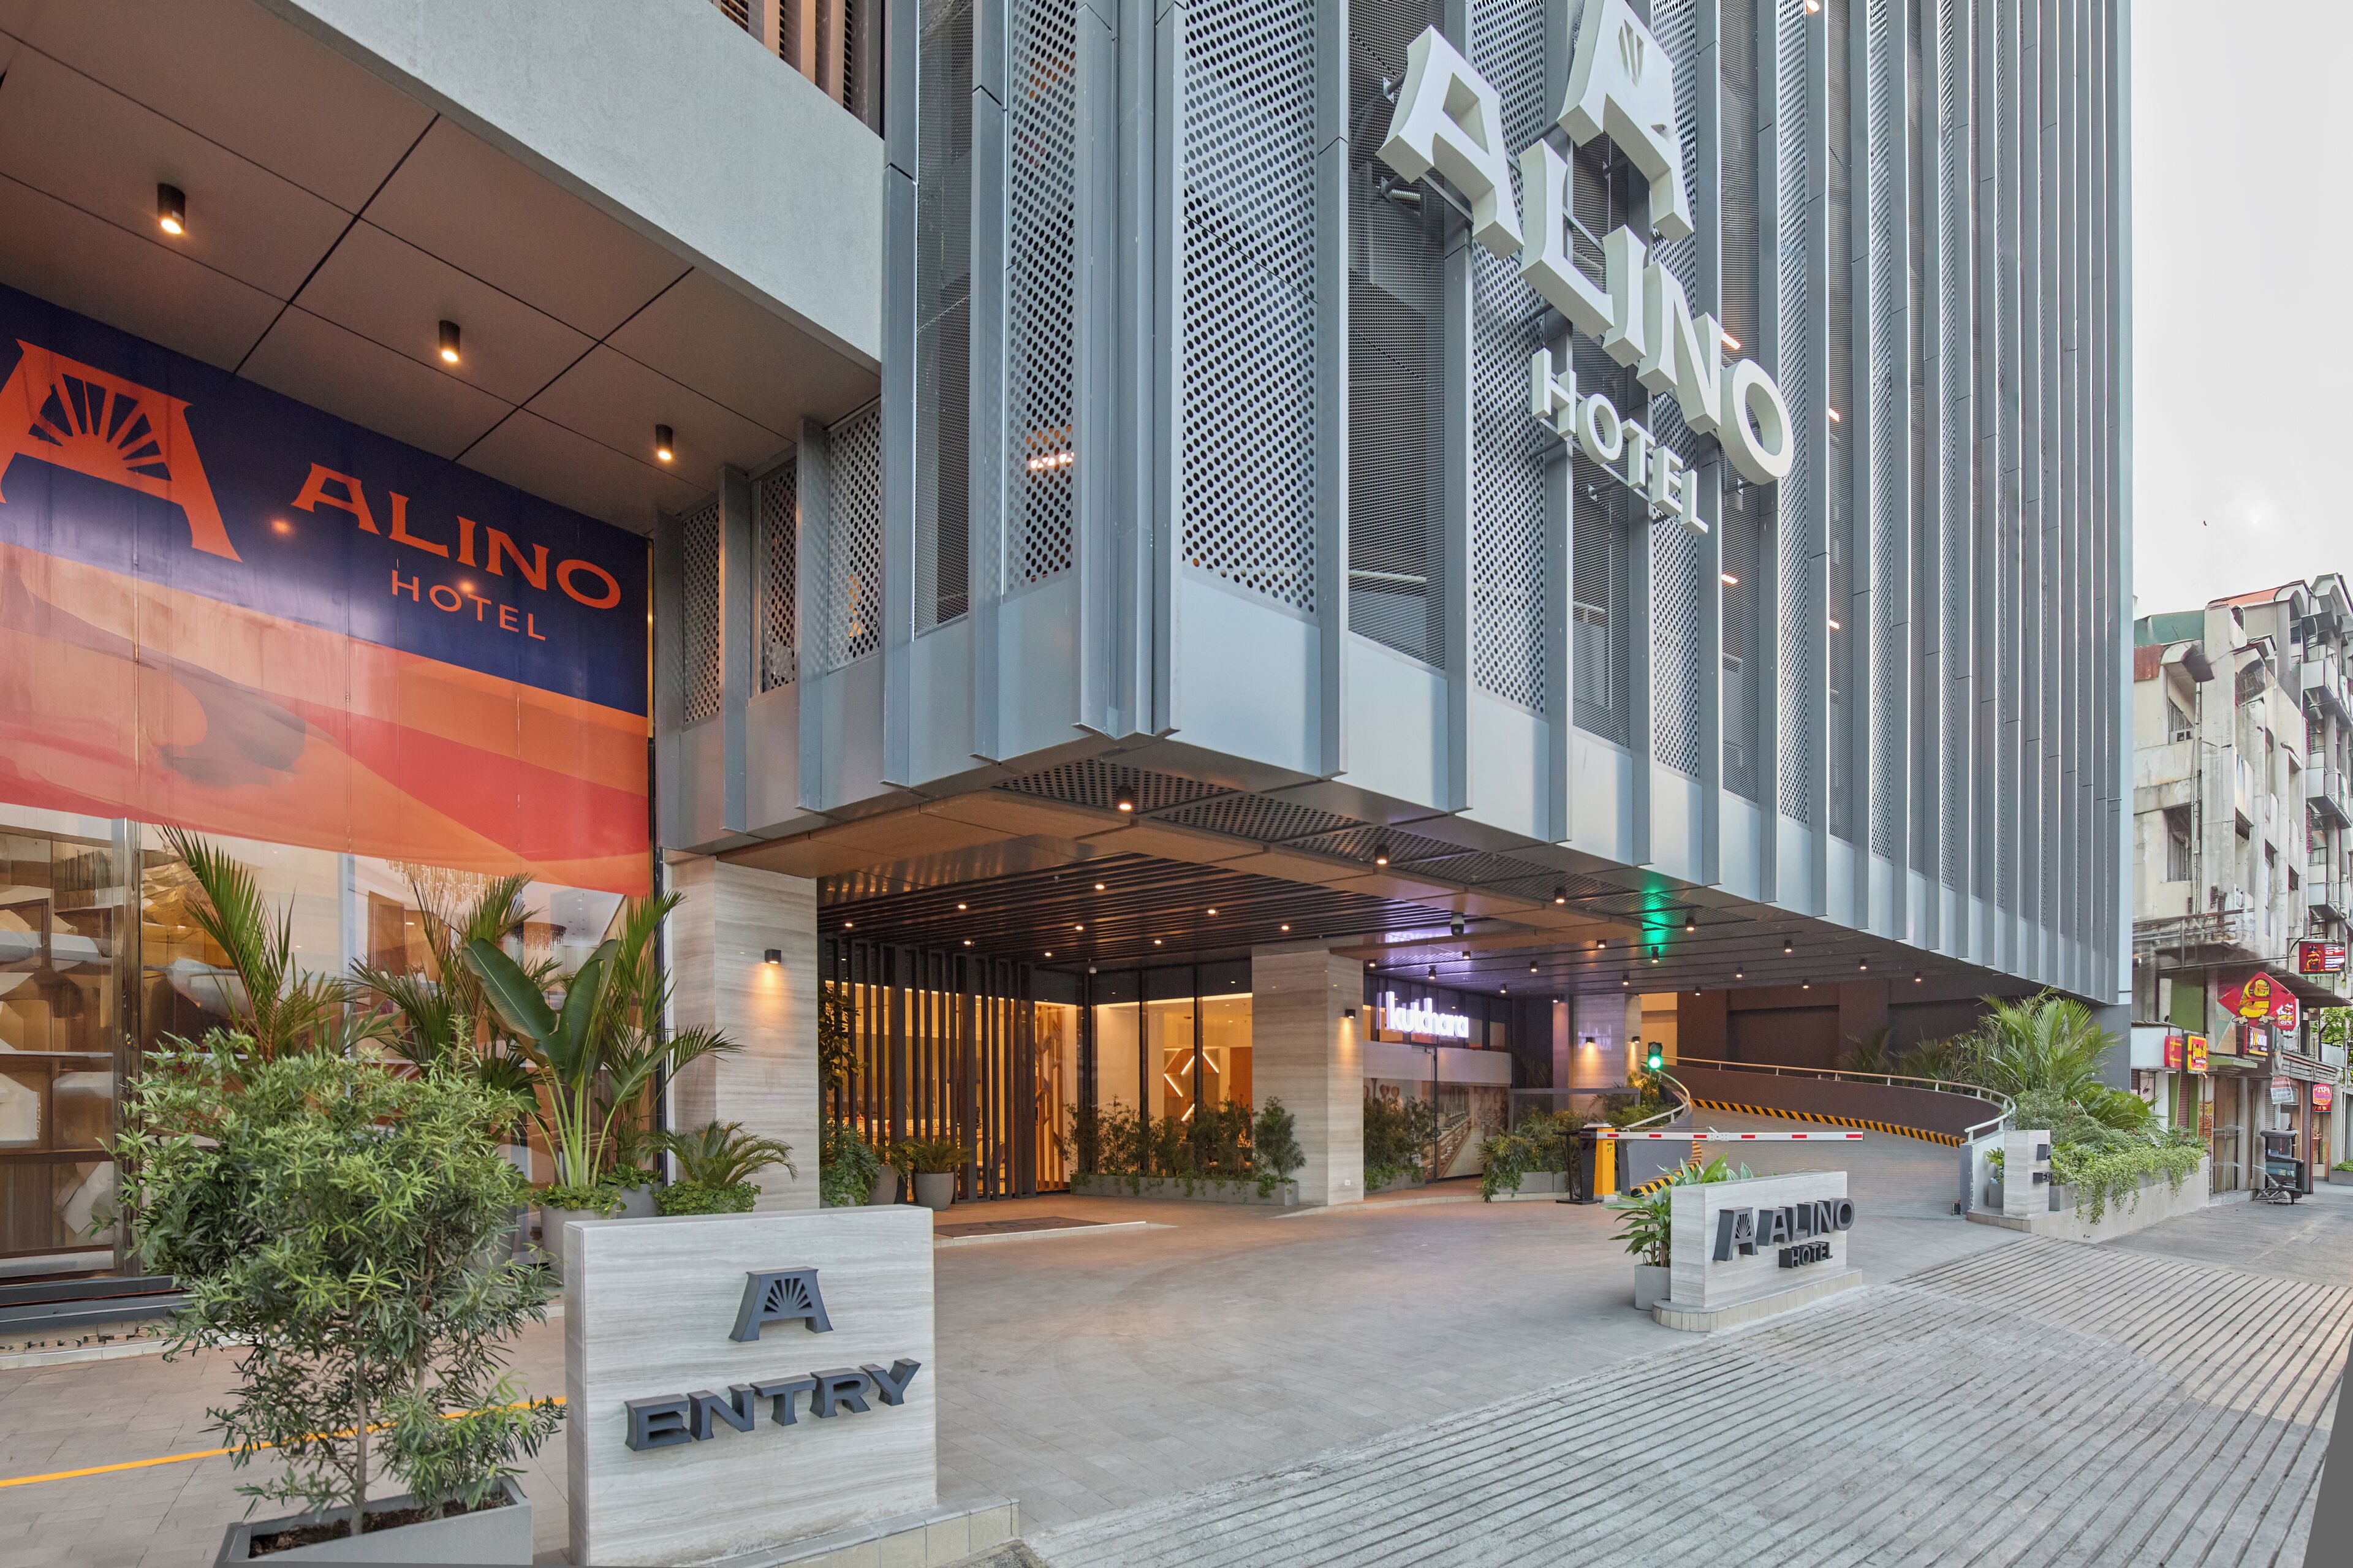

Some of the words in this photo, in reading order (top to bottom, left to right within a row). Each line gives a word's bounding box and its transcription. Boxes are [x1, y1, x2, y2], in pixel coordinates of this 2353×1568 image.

[1376, 25, 1794, 485] ALINO
[1532, 347, 1708, 535] HOTEL
[291, 463, 621, 609] ALINO
[392, 569, 545, 640] HOTEL
[1385, 991, 1469, 1038] kutchara
[1756, 1198, 1855, 1246] ALINO
[1779, 1241, 1833, 1268] HOTEL
[624, 1358, 921, 1451] ENTRY
